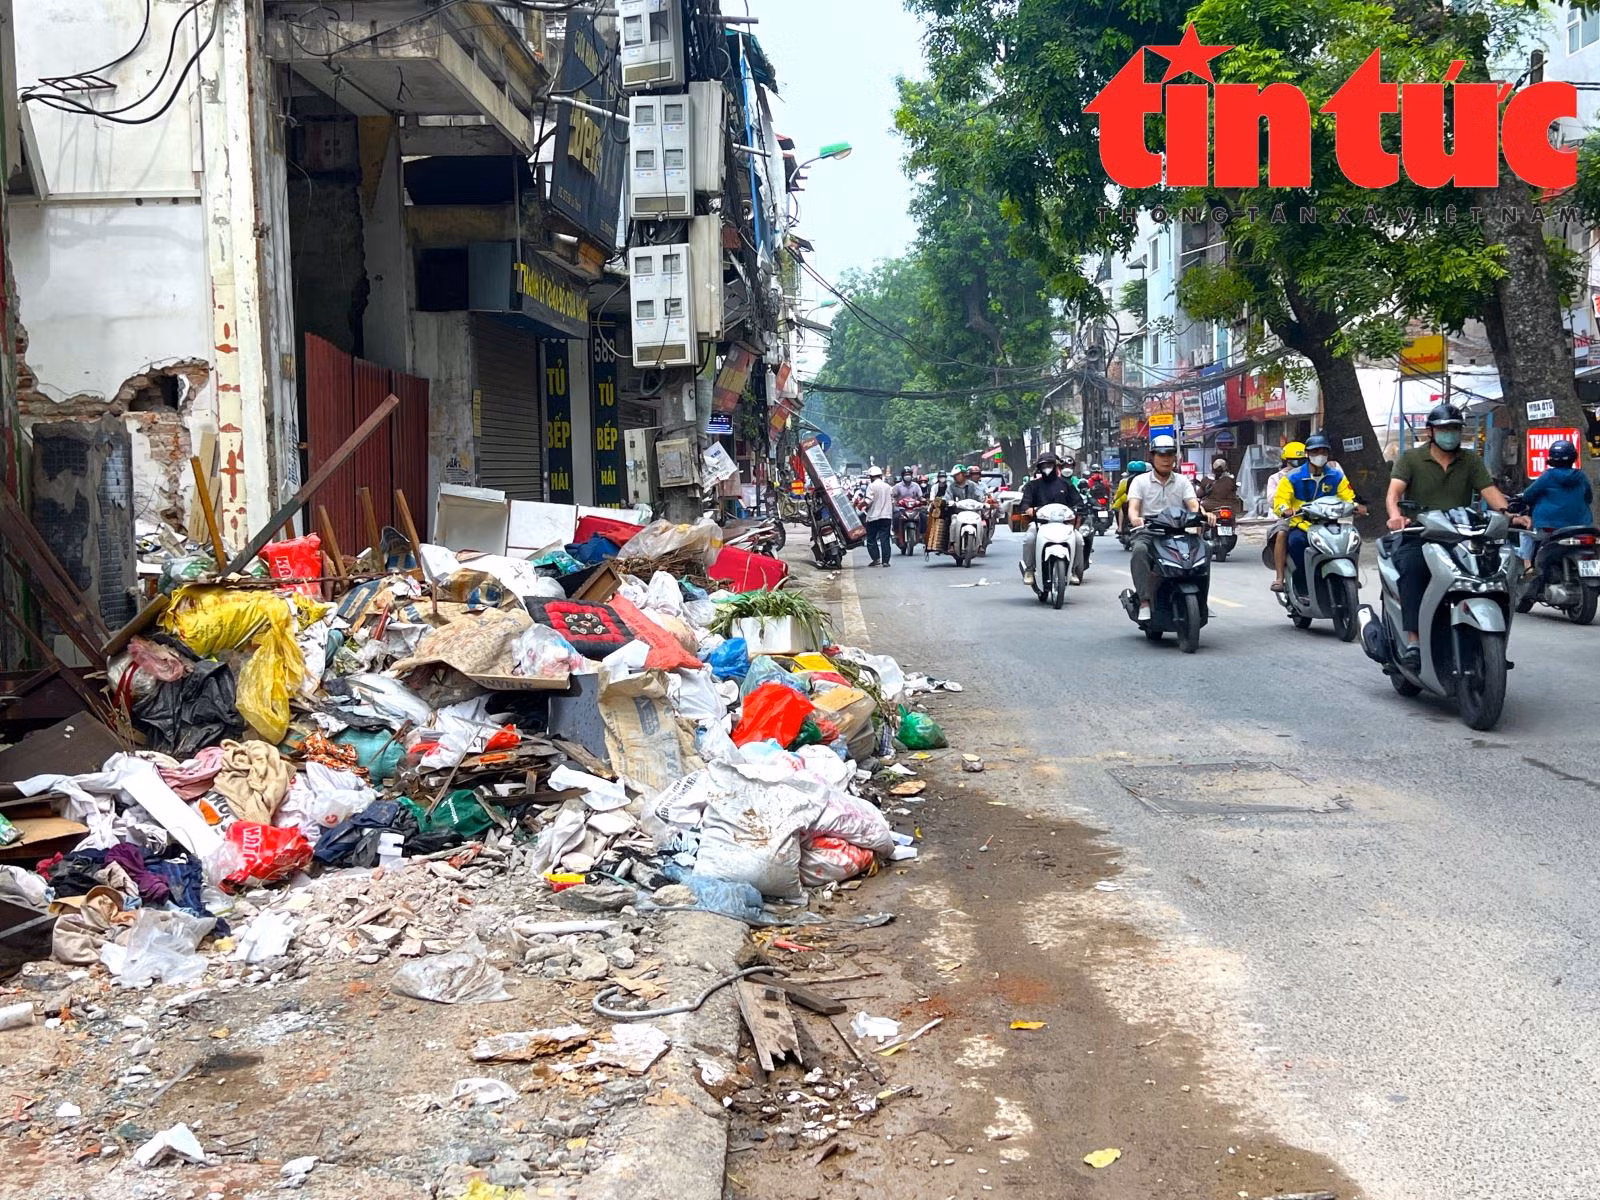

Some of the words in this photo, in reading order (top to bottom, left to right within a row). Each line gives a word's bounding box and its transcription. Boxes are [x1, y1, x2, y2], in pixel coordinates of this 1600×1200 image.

[546, 359, 566, 396] TỦ
[599, 376, 614, 407] TỦ
[547, 412, 571, 449] BẾP
[596, 420, 618, 450] BẾP
[601, 465, 616, 486] HẢI
